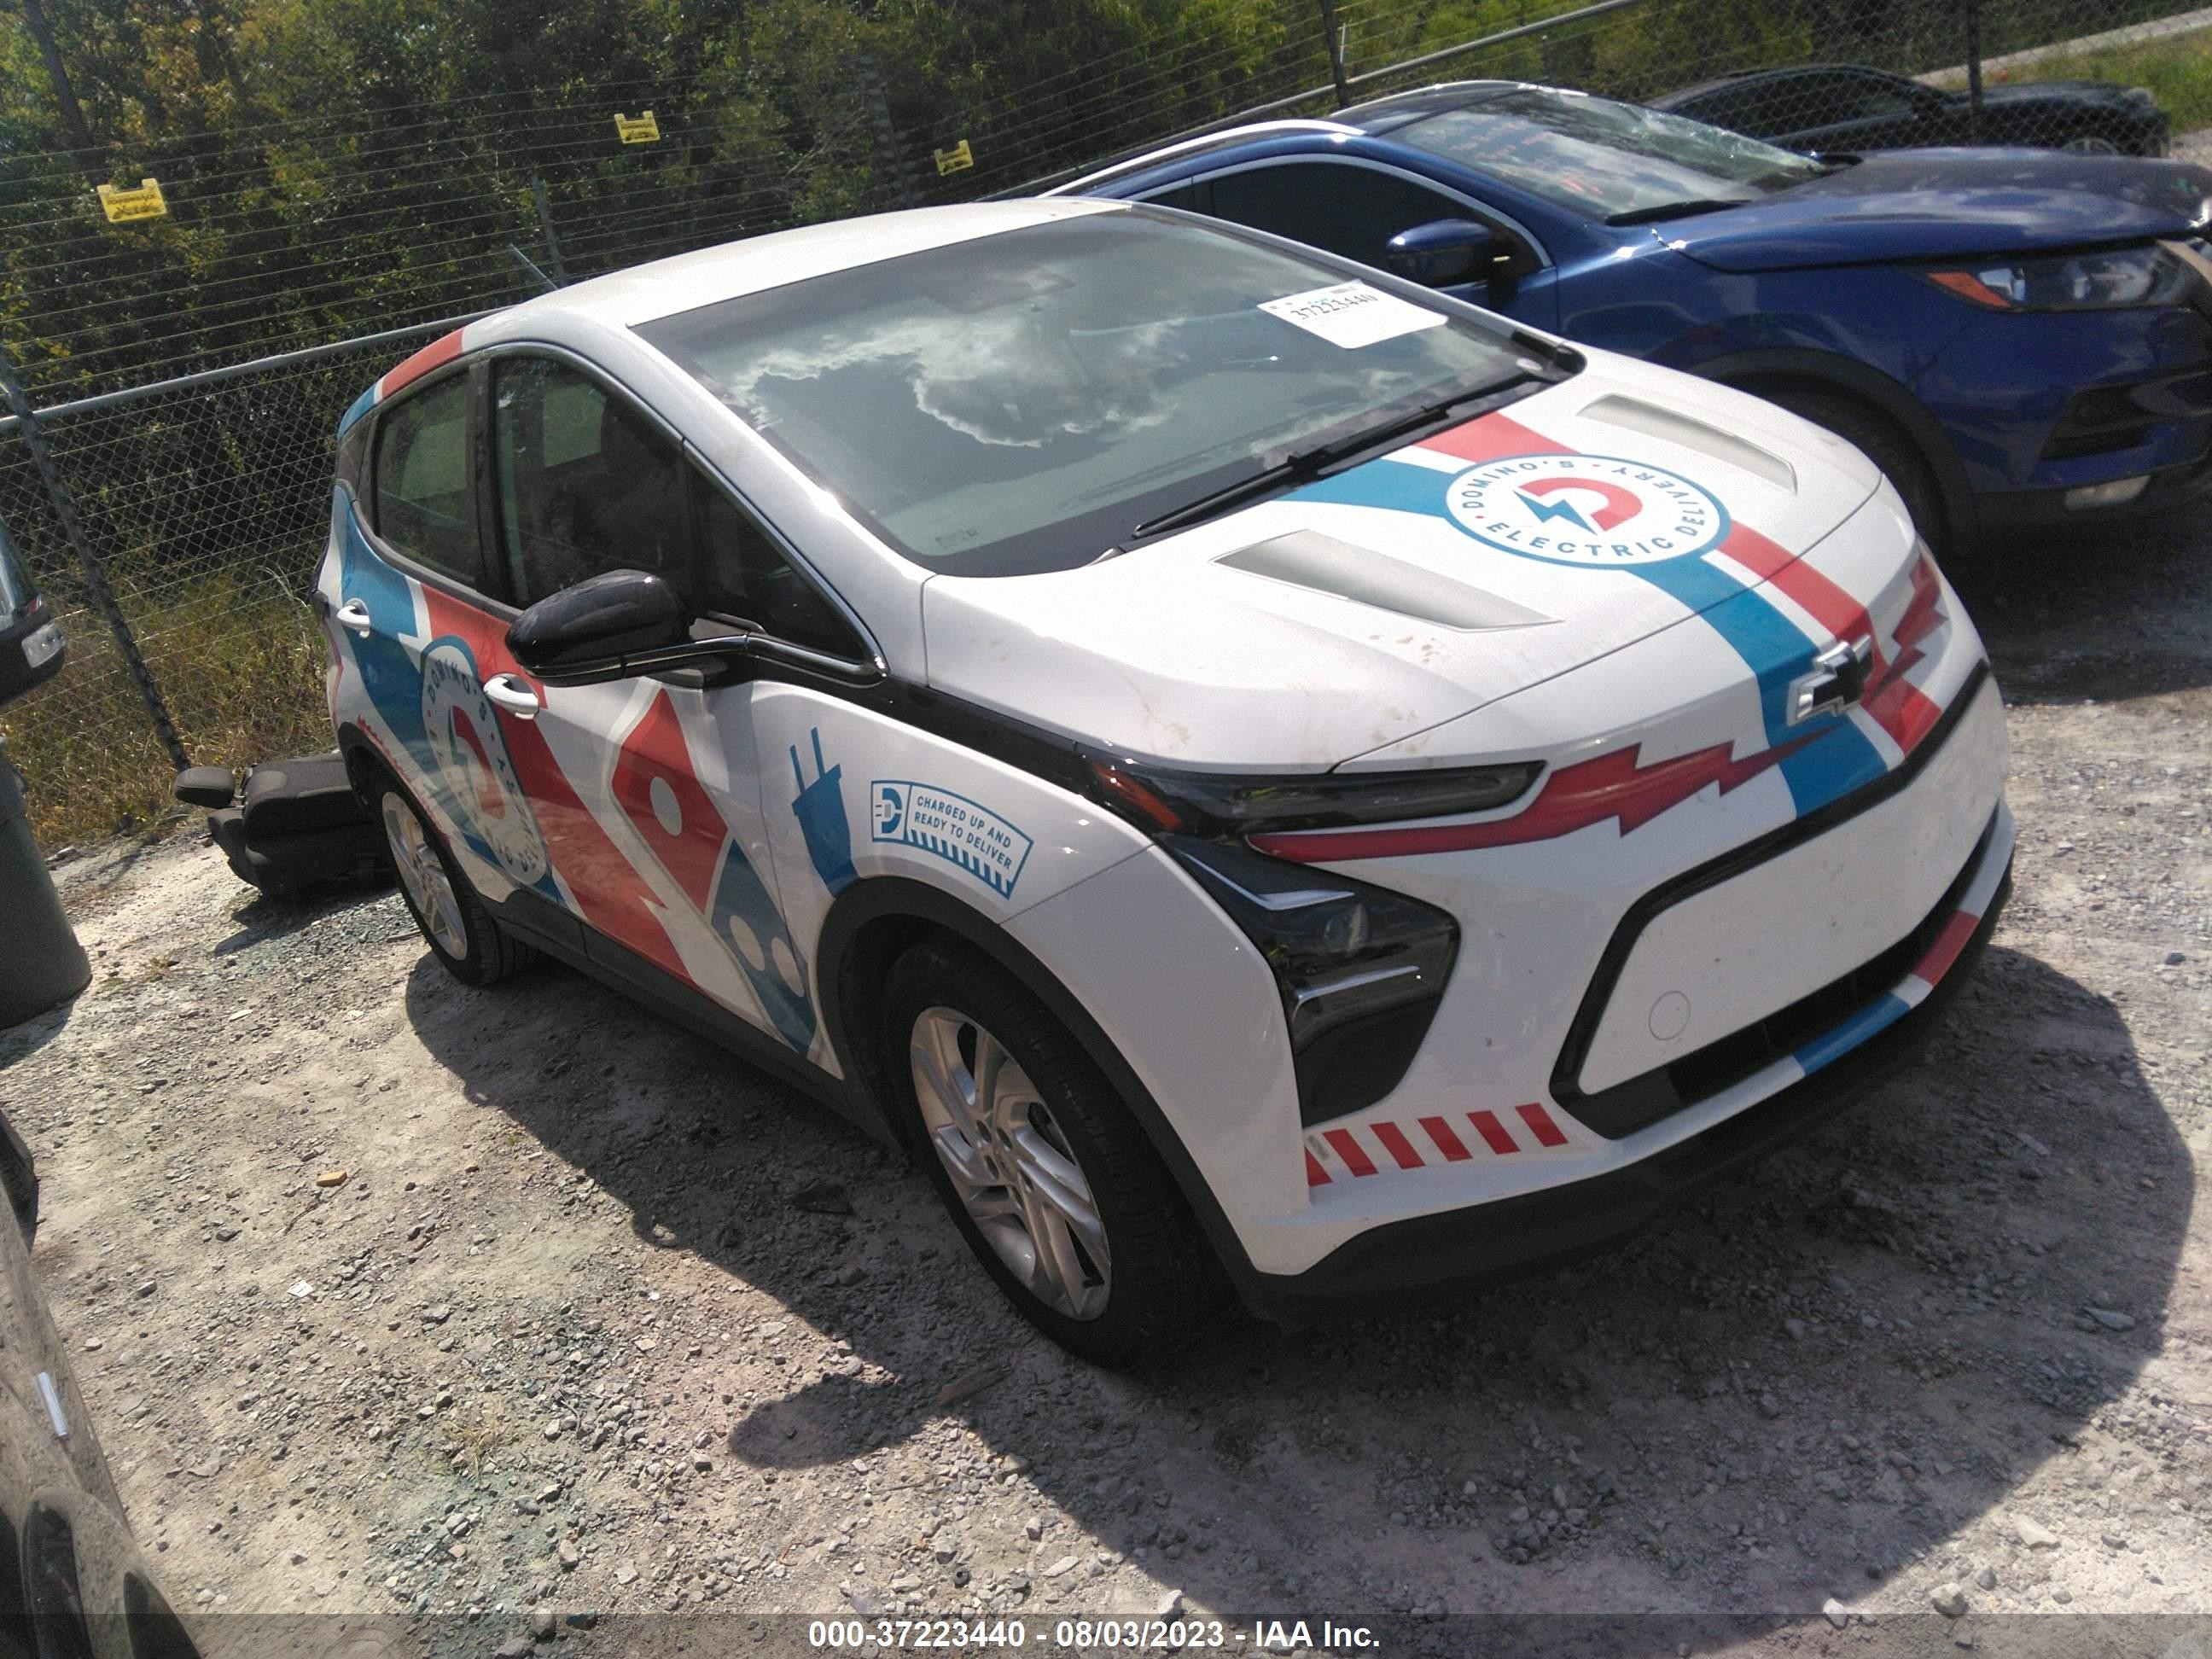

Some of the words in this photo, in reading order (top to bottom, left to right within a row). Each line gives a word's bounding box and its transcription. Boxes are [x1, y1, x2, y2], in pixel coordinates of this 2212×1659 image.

[1290, 293, 1379, 320] 37223440
[1460, 459, 1575, 510] DOMINO'S
[1486, 521, 1674, 557] ELECTRIC
[1610, 467, 1706, 538] DELIVERY
[914, 811, 948, 832] READY
[951, 824, 963, 839] TO
[965, 831, 1013, 871] DELIVER
[917, 795, 967, 822] CHARGED
[969, 814, 985, 830] UP
[987, 826, 1012, 849] AND
